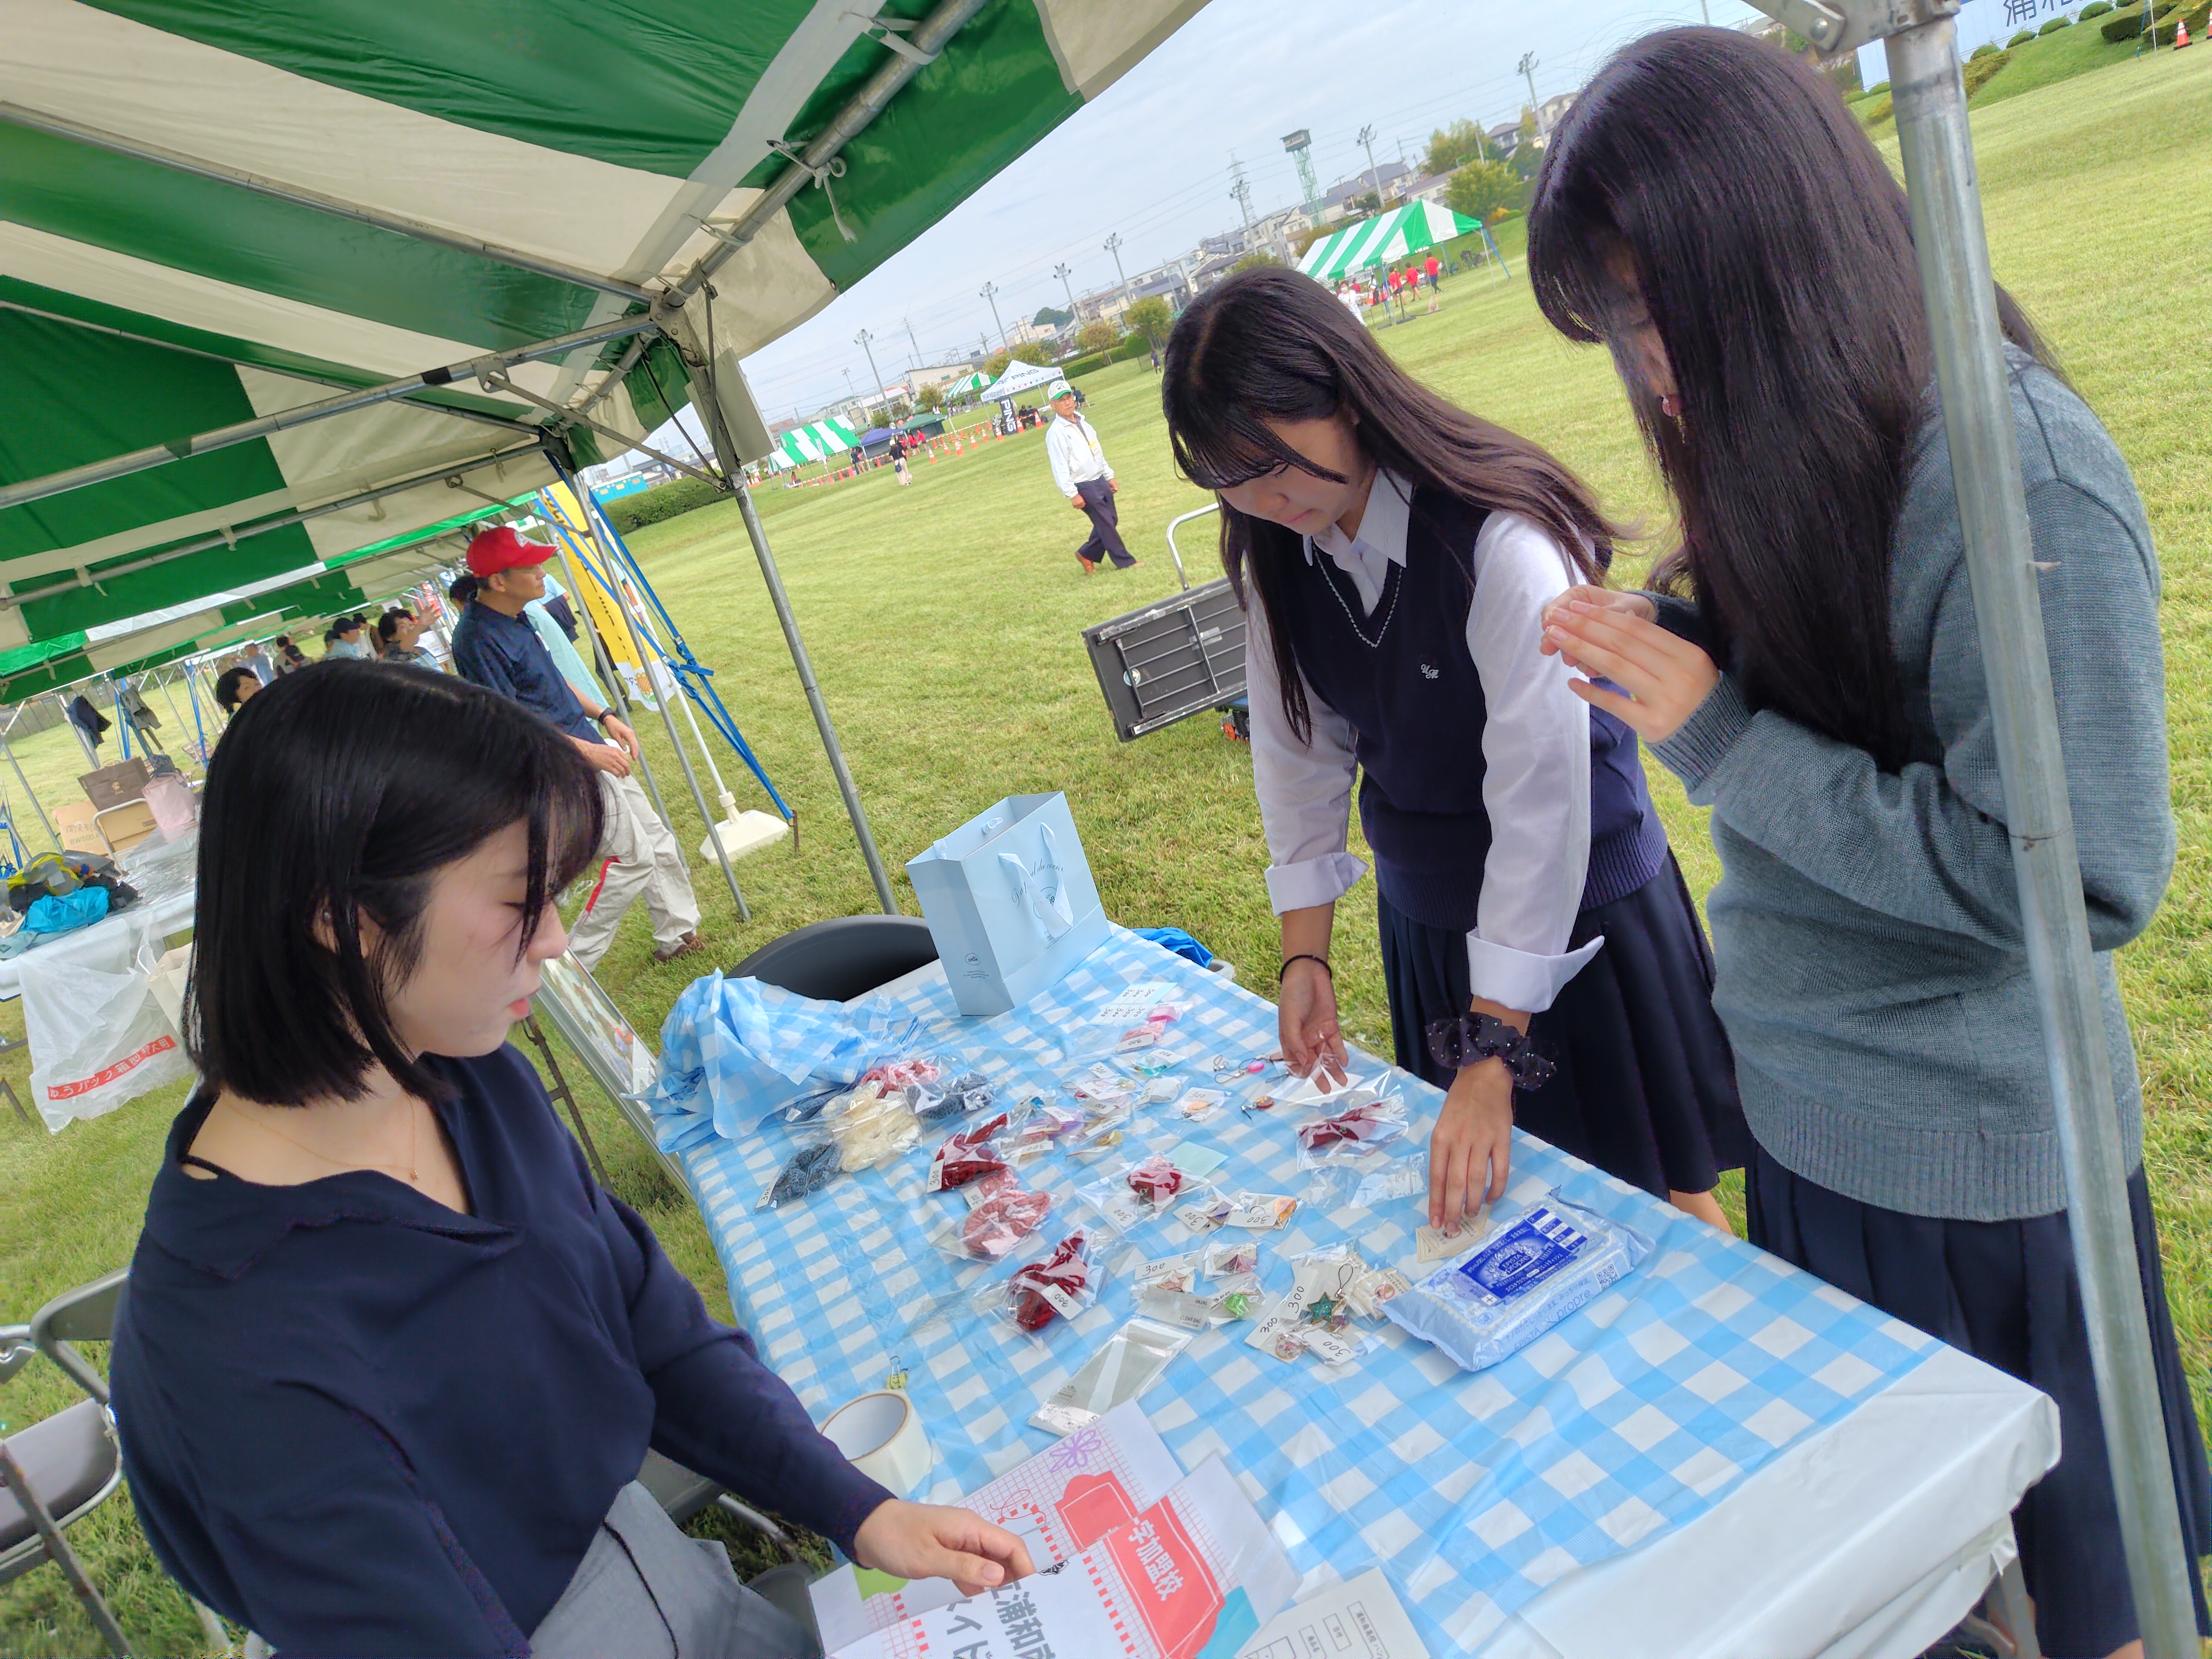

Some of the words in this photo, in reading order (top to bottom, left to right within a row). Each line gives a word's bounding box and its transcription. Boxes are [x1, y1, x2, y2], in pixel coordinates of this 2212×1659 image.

[1011, 368, 1039, 380] PING
[1001, 399, 1016, 433] PING
[48, 1037, 171, 1098] ゆうパック箱型特大用
[1091, 1065, 1107, 1074] 300
[1054, 1110, 1069, 1118] 300
[1027, 1142, 1046, 1151] 300
[929, 1170, 940, 1186] 300
[760, 1188, 771, 1202] 300
[1114, 1209, 1131, 1222] 300
[1185, 1212, 1203, 1226] 300
[1247, 1216, 1270, 1224] 300
[1502, 1253, 1522, 1269] EPISTA
[1504, 1254, 1529, 1275] propre
[1142, 1263, 1165, 1277] 300
[1054, 1293, 1069, 1307] 300
[1212, 1291, 1230, 1303] 300
[1288, 1286, 1304, 1314] 300
[1260, 1317, 1278, 1333] 300
[1513, 1327, 1541, 1351] EPISTA
[1555, 1288, 1592, 1321] propre
[1323, 1341, 1351, 1357] 300
